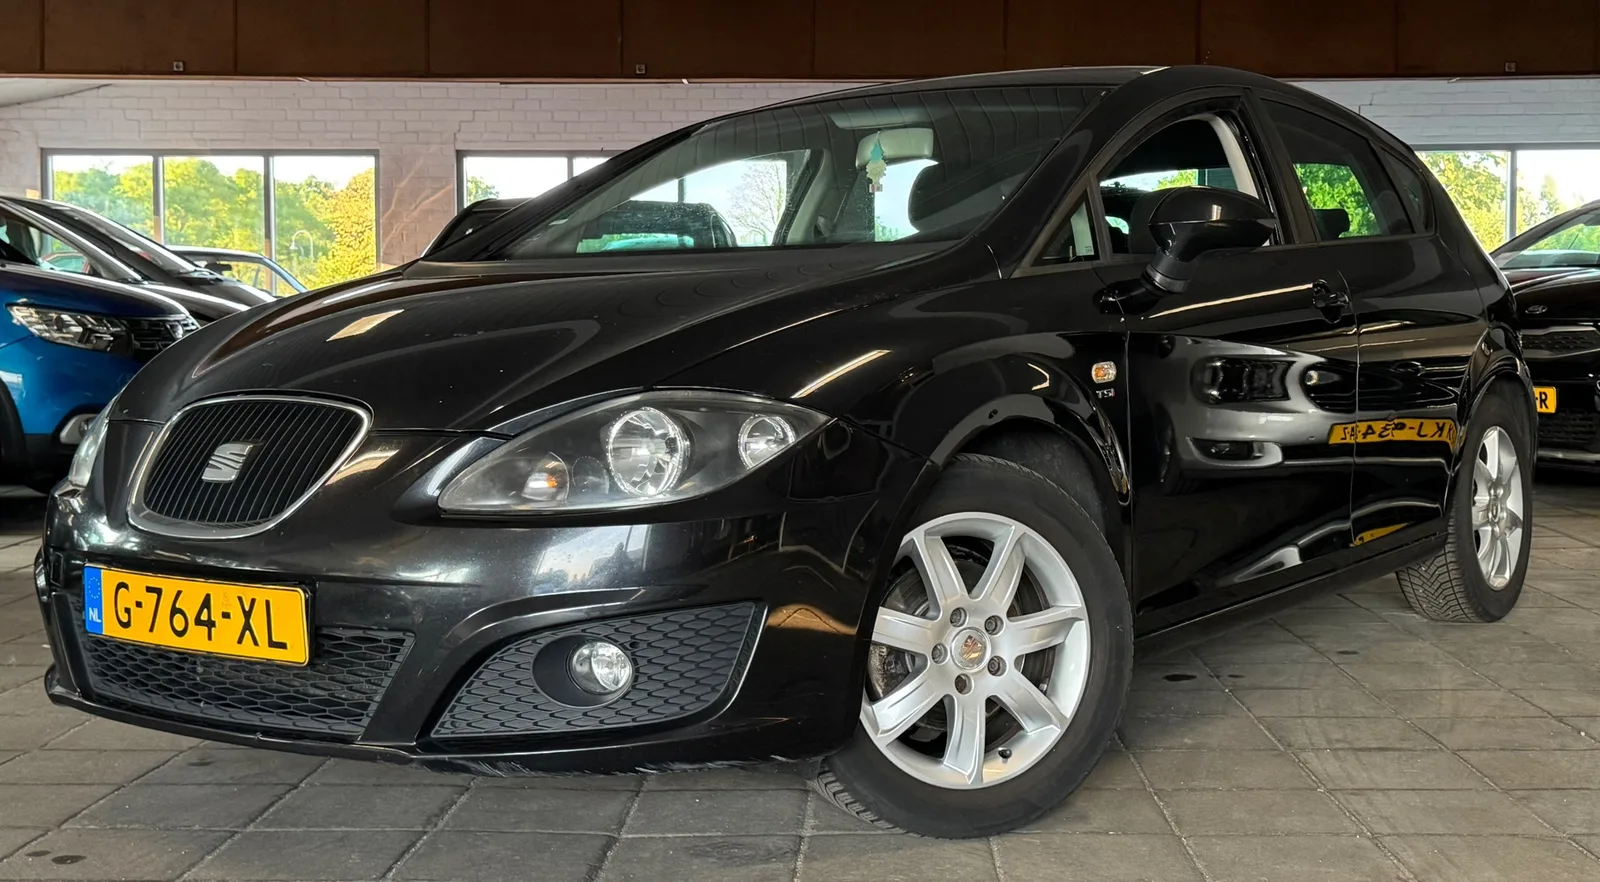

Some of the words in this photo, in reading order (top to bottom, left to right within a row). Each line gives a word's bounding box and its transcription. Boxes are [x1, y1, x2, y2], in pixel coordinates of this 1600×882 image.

[1096, 388, 1115, 399] TSI
[1535, 391, 1549, 410] -R
[88, 606, 102, 623] NL
[114, 581, 288, 650] G-764-XL
